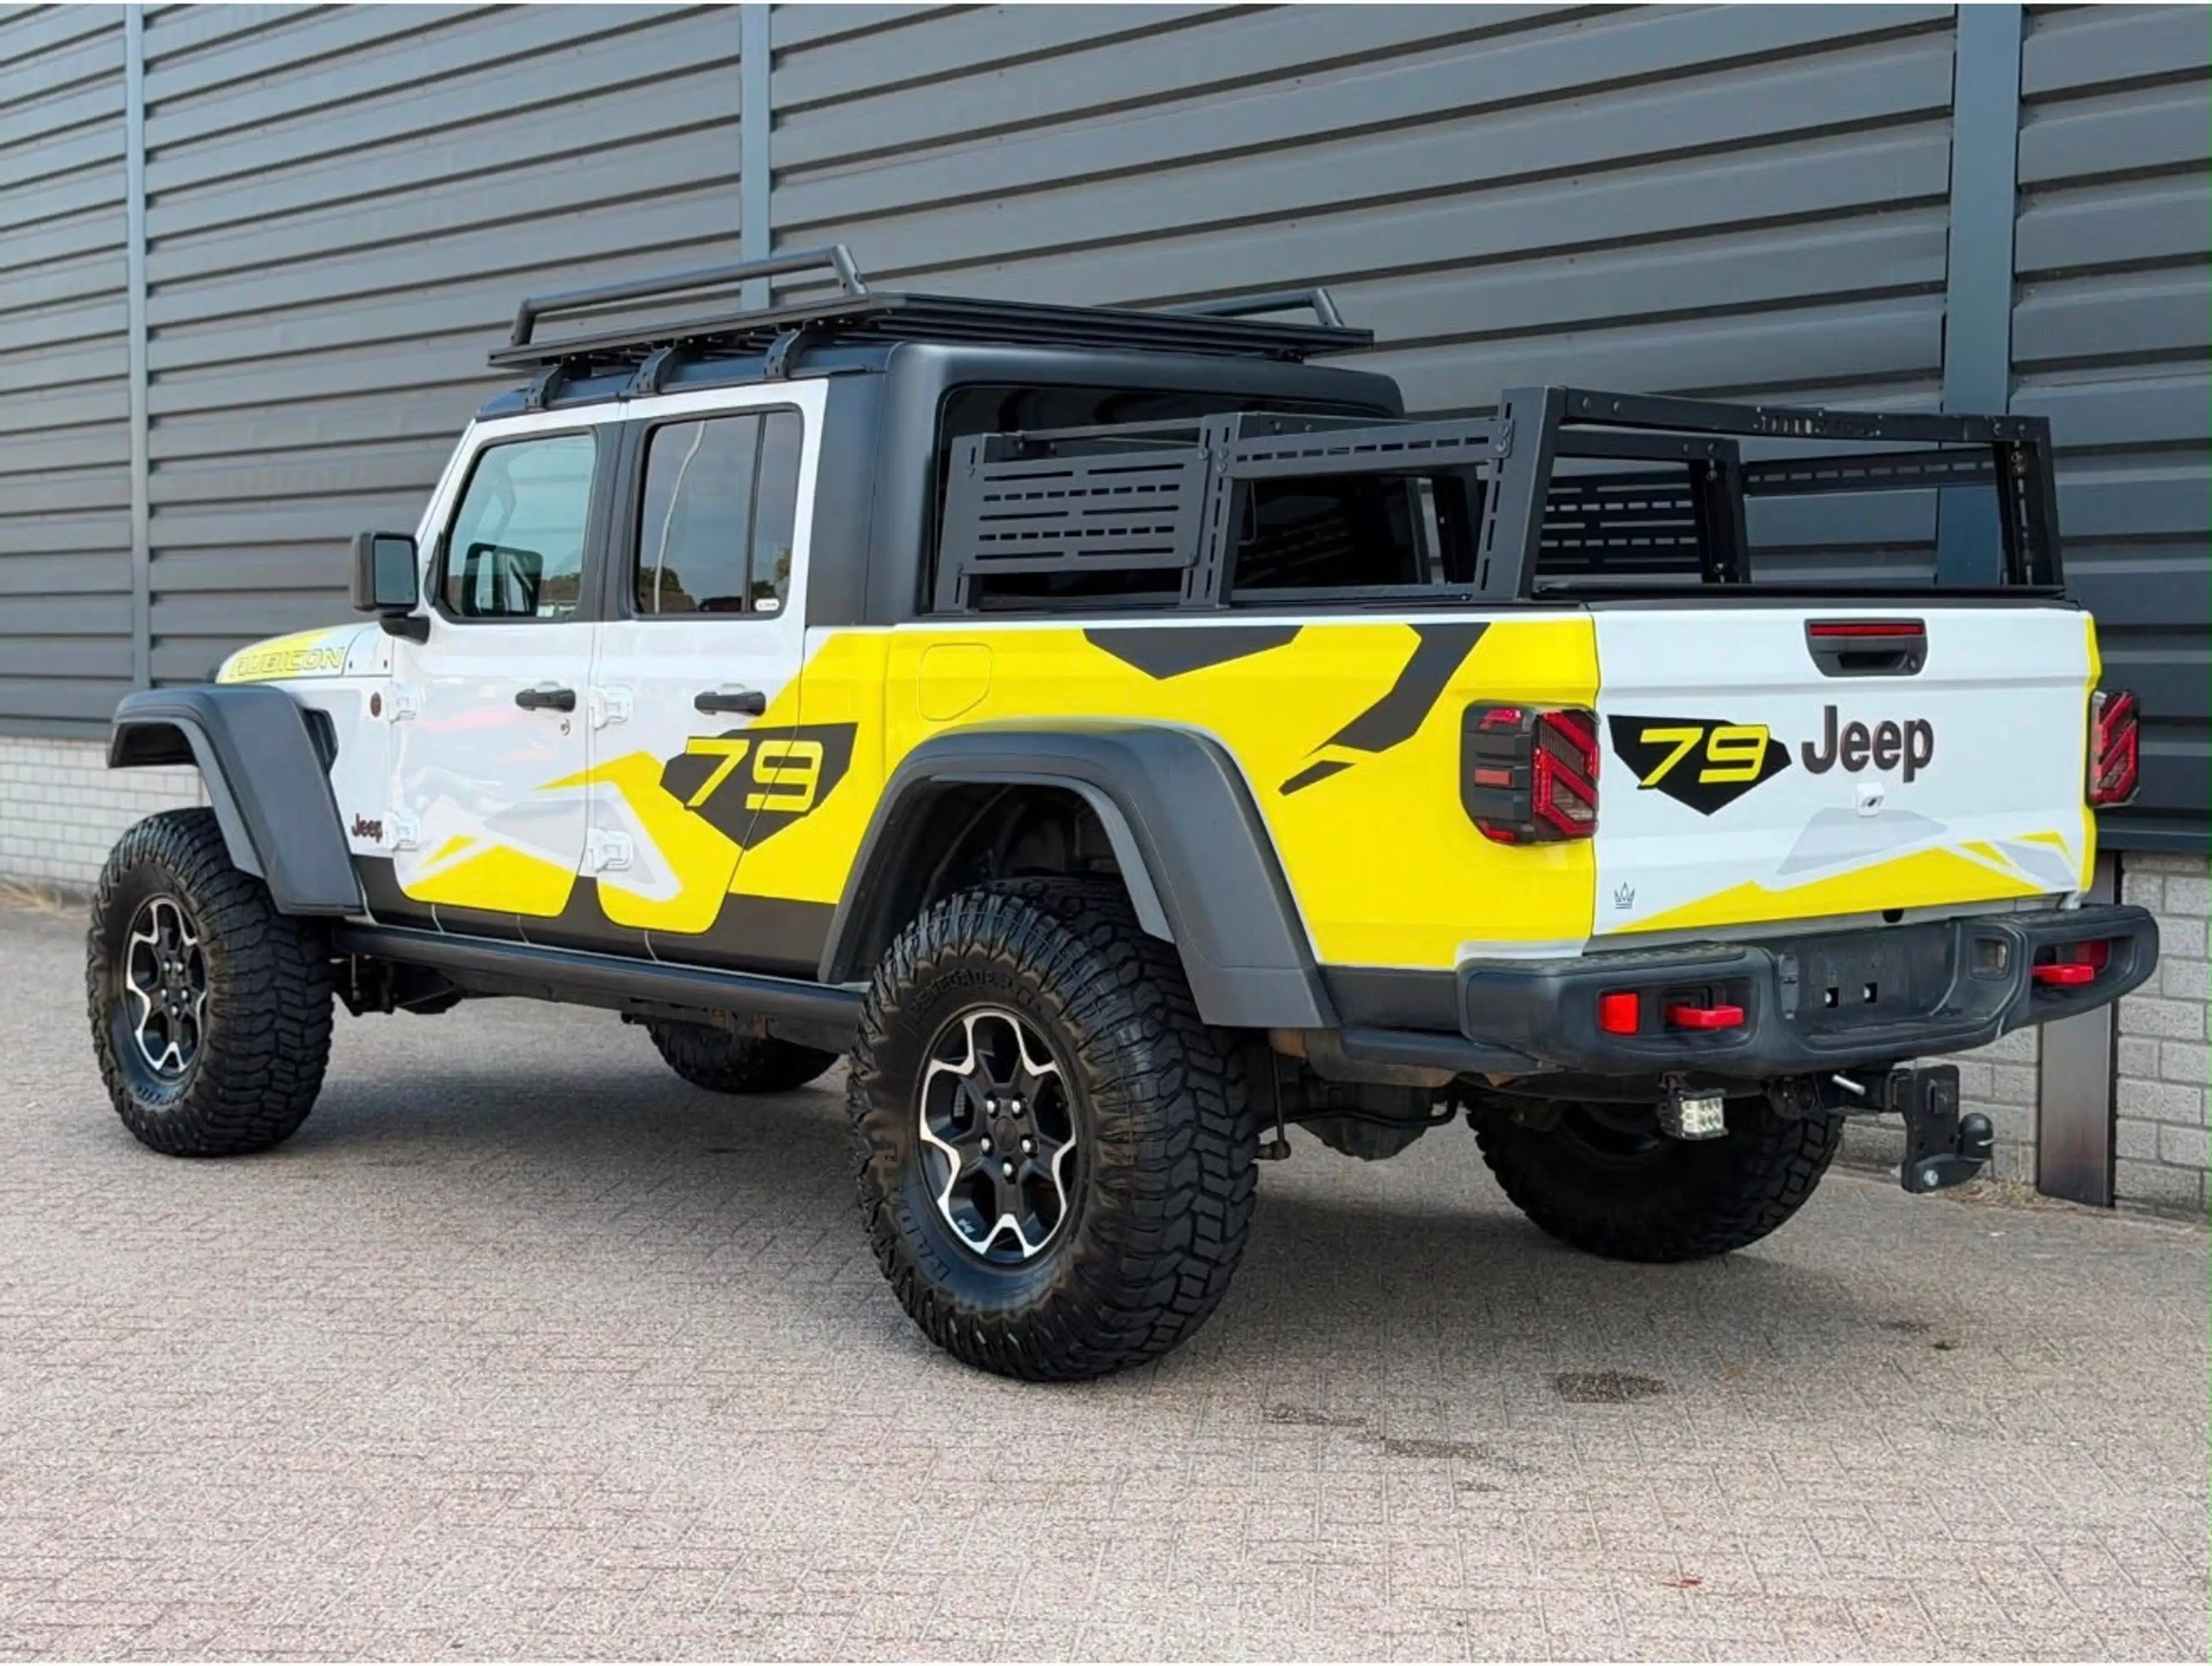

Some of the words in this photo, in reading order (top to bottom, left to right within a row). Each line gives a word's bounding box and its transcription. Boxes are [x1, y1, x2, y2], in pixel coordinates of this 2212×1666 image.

[686, 739, 823, 812] 79
[1639, 725, 1770, 786] 79
[1801, 705, 1933, 783] Jeep
[351, 813, 382, 843] Jeep
